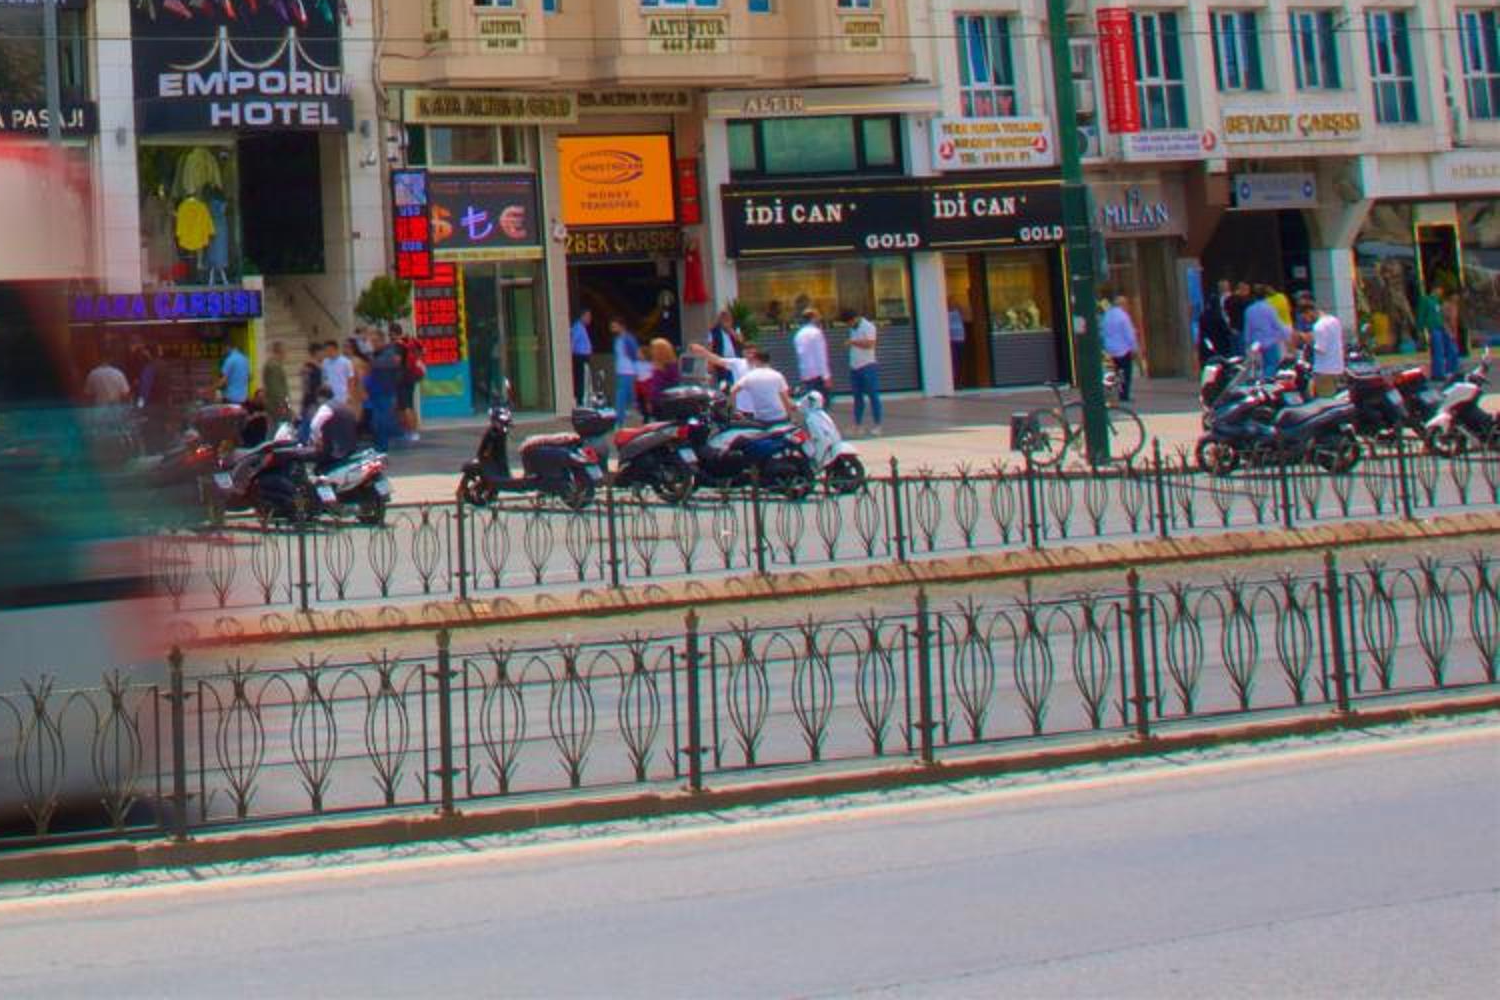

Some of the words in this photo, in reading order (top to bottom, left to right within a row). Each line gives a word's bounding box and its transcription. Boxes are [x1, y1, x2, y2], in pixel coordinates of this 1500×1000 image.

[210, 101, 339, 126] HOTEL
[1224, 113, 1291, 134] BEYAZIT
[790, 203, 844, 223] CAN
[972, 196, 1016, 217] CAN
[866, 233, 919, 249] GOLD
[1019, 225, 1063, 241] GOLD
